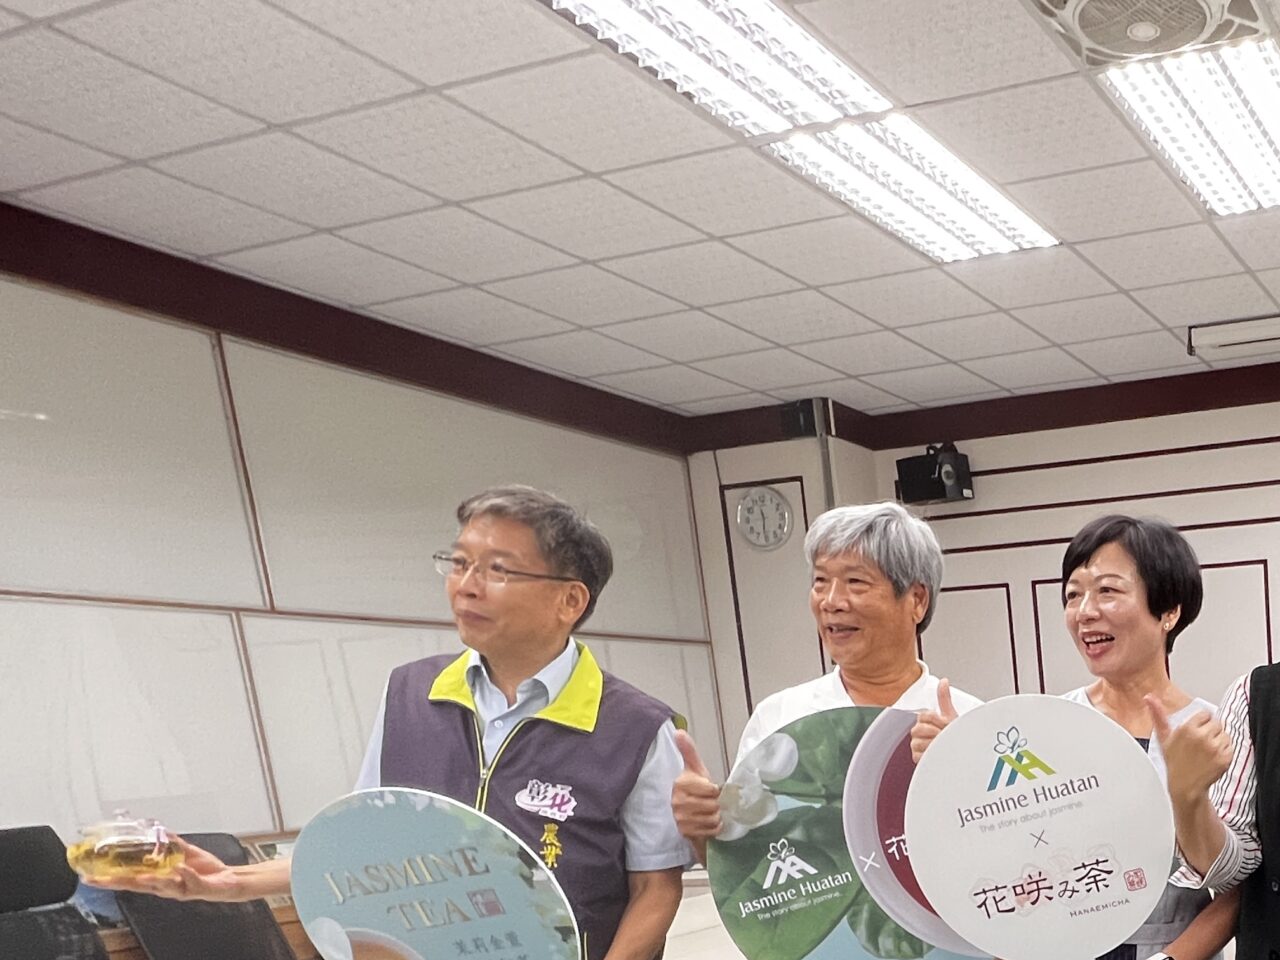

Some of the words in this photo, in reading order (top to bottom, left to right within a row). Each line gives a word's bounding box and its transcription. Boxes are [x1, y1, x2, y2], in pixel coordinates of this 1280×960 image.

[958, 794, 1029, 828] Jasmine
[1033, 775, 1100, 804] Huatan
[323, 846, 490, 905] JASMINE
[738, 887, 798, 917] Jasmine
[799, 871, 853, 898] Huatan
[973, 858, 1114, 919] 花咲み茶
[386, 897, 472, 932] TEA
[1069, 898, 1130, 918] HANAEMICHA
